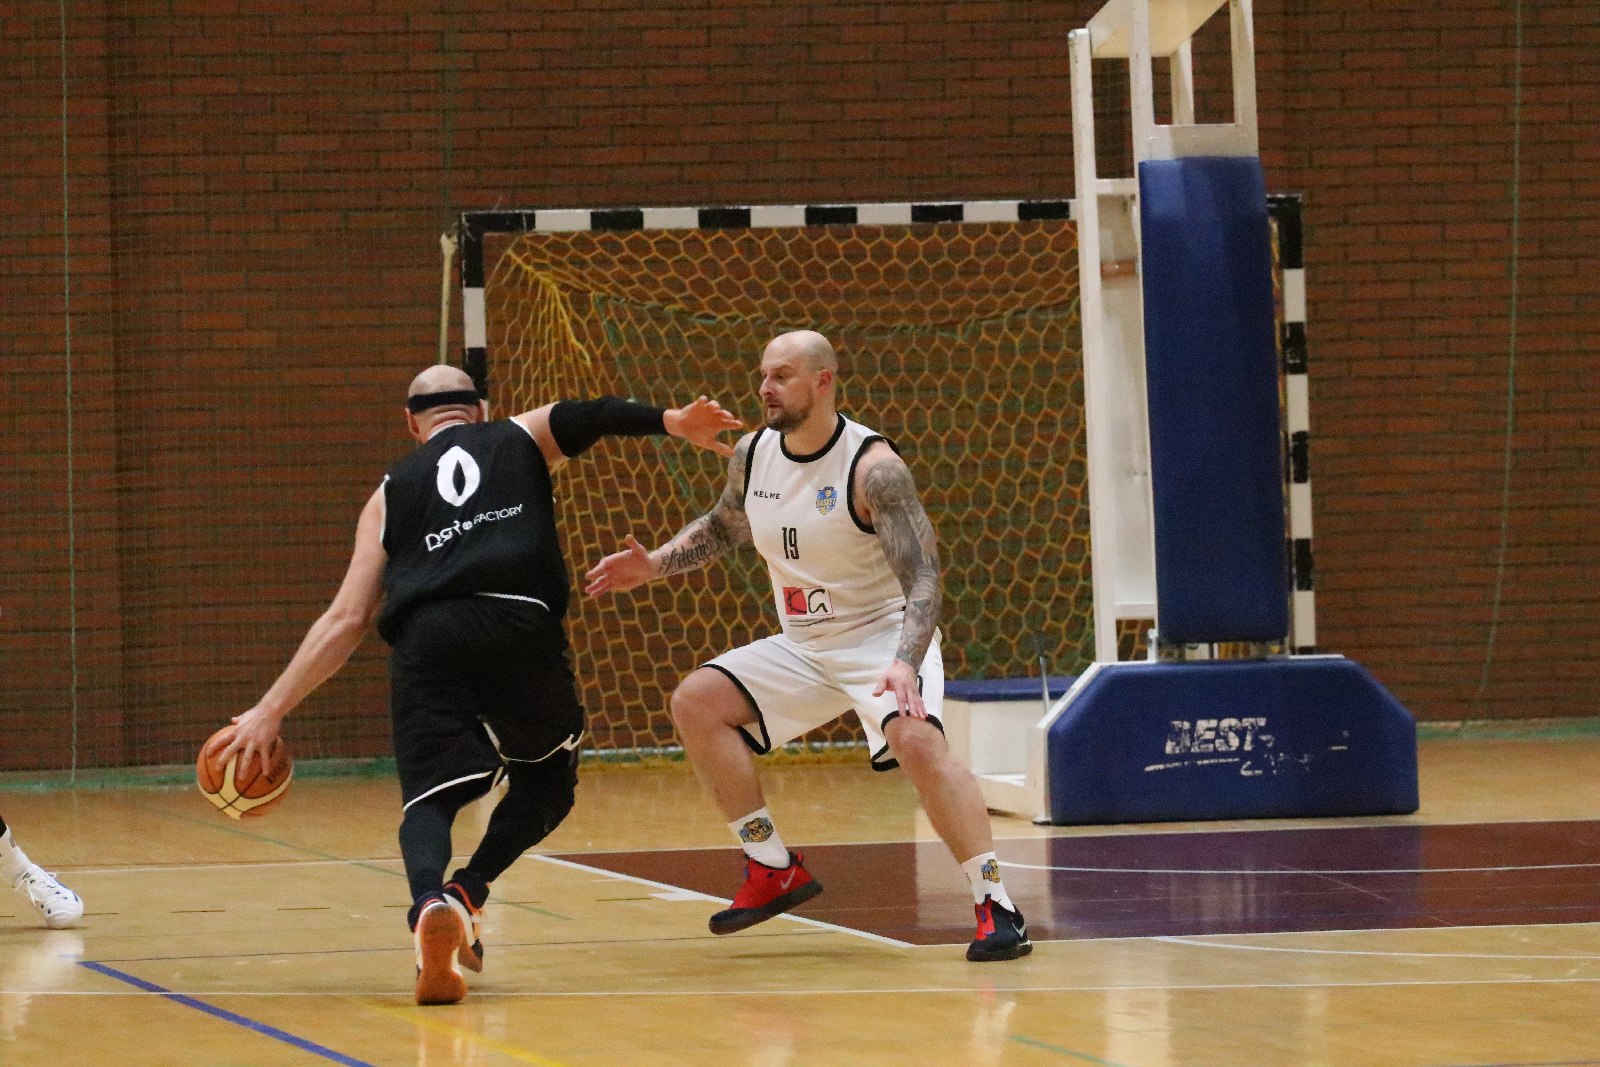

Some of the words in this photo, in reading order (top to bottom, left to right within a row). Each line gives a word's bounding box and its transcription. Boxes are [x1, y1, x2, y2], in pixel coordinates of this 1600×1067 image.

[436, 445, 481, 507] 0
[753, 490, 781, 500] KELME
[473, 503, 523, 525] FACTORY
[782, 526, 800, 560] 19
